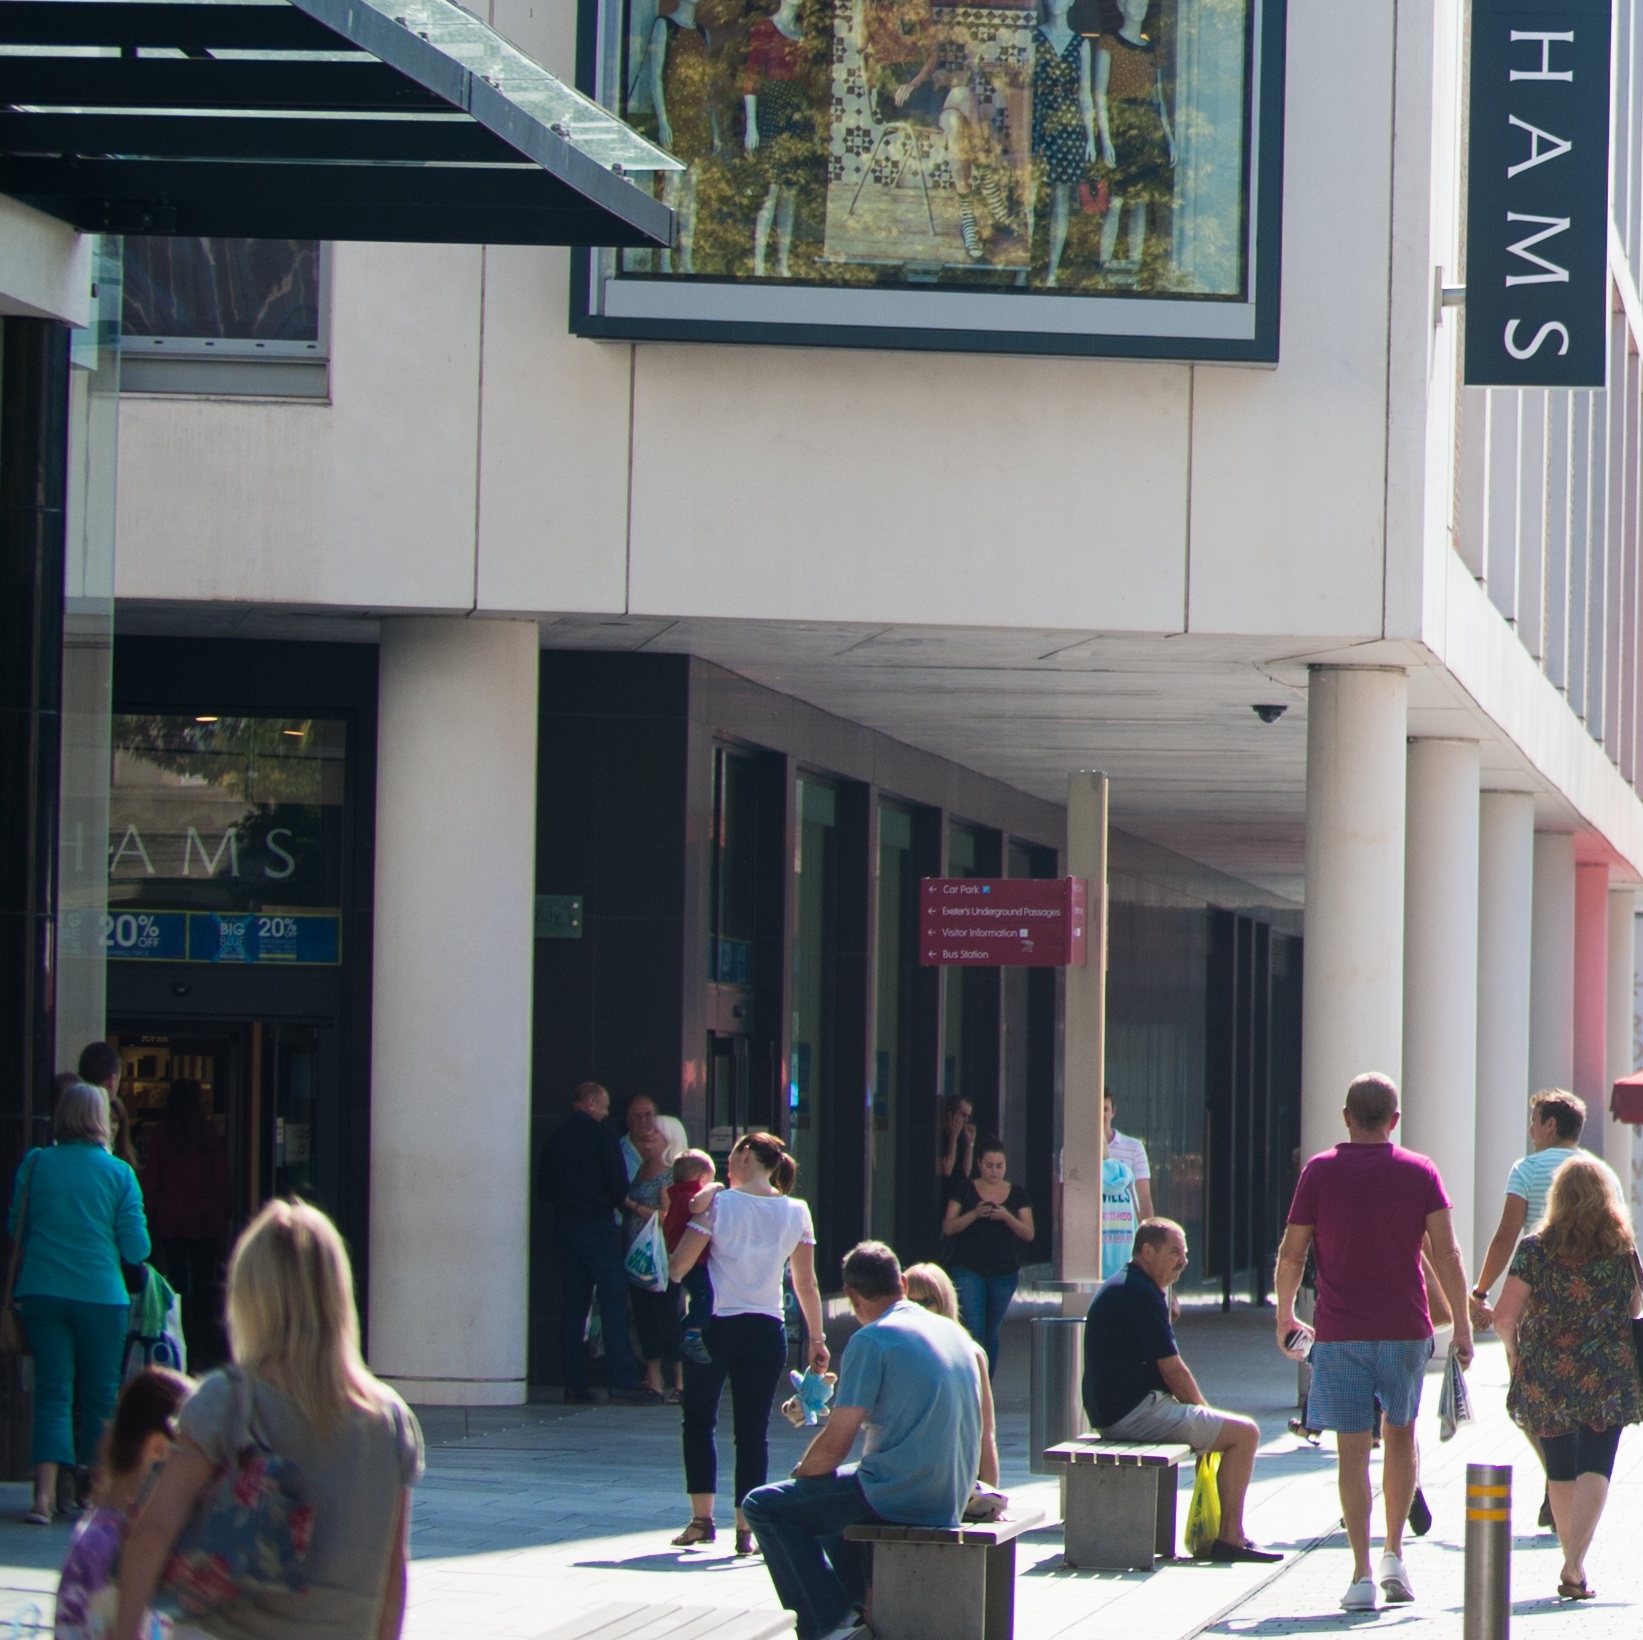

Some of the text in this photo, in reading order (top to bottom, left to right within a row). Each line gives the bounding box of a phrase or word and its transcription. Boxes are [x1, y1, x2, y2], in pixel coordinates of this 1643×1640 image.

[942, 885, 979, 895] Car Park
[971, 907, 1023, 918] Underground
[1023, 907, 1061, 918] Passages
[219, 922, 245, 936] BIG
[258, 917, 297, 938] 20%
[942, 928, 1017, 937] Visitor Information
[138, 937, 160, 948] OFF
[942, 949, 989, 959] Bus Station
[1103, 1188, 1131, 1203] ILLS
